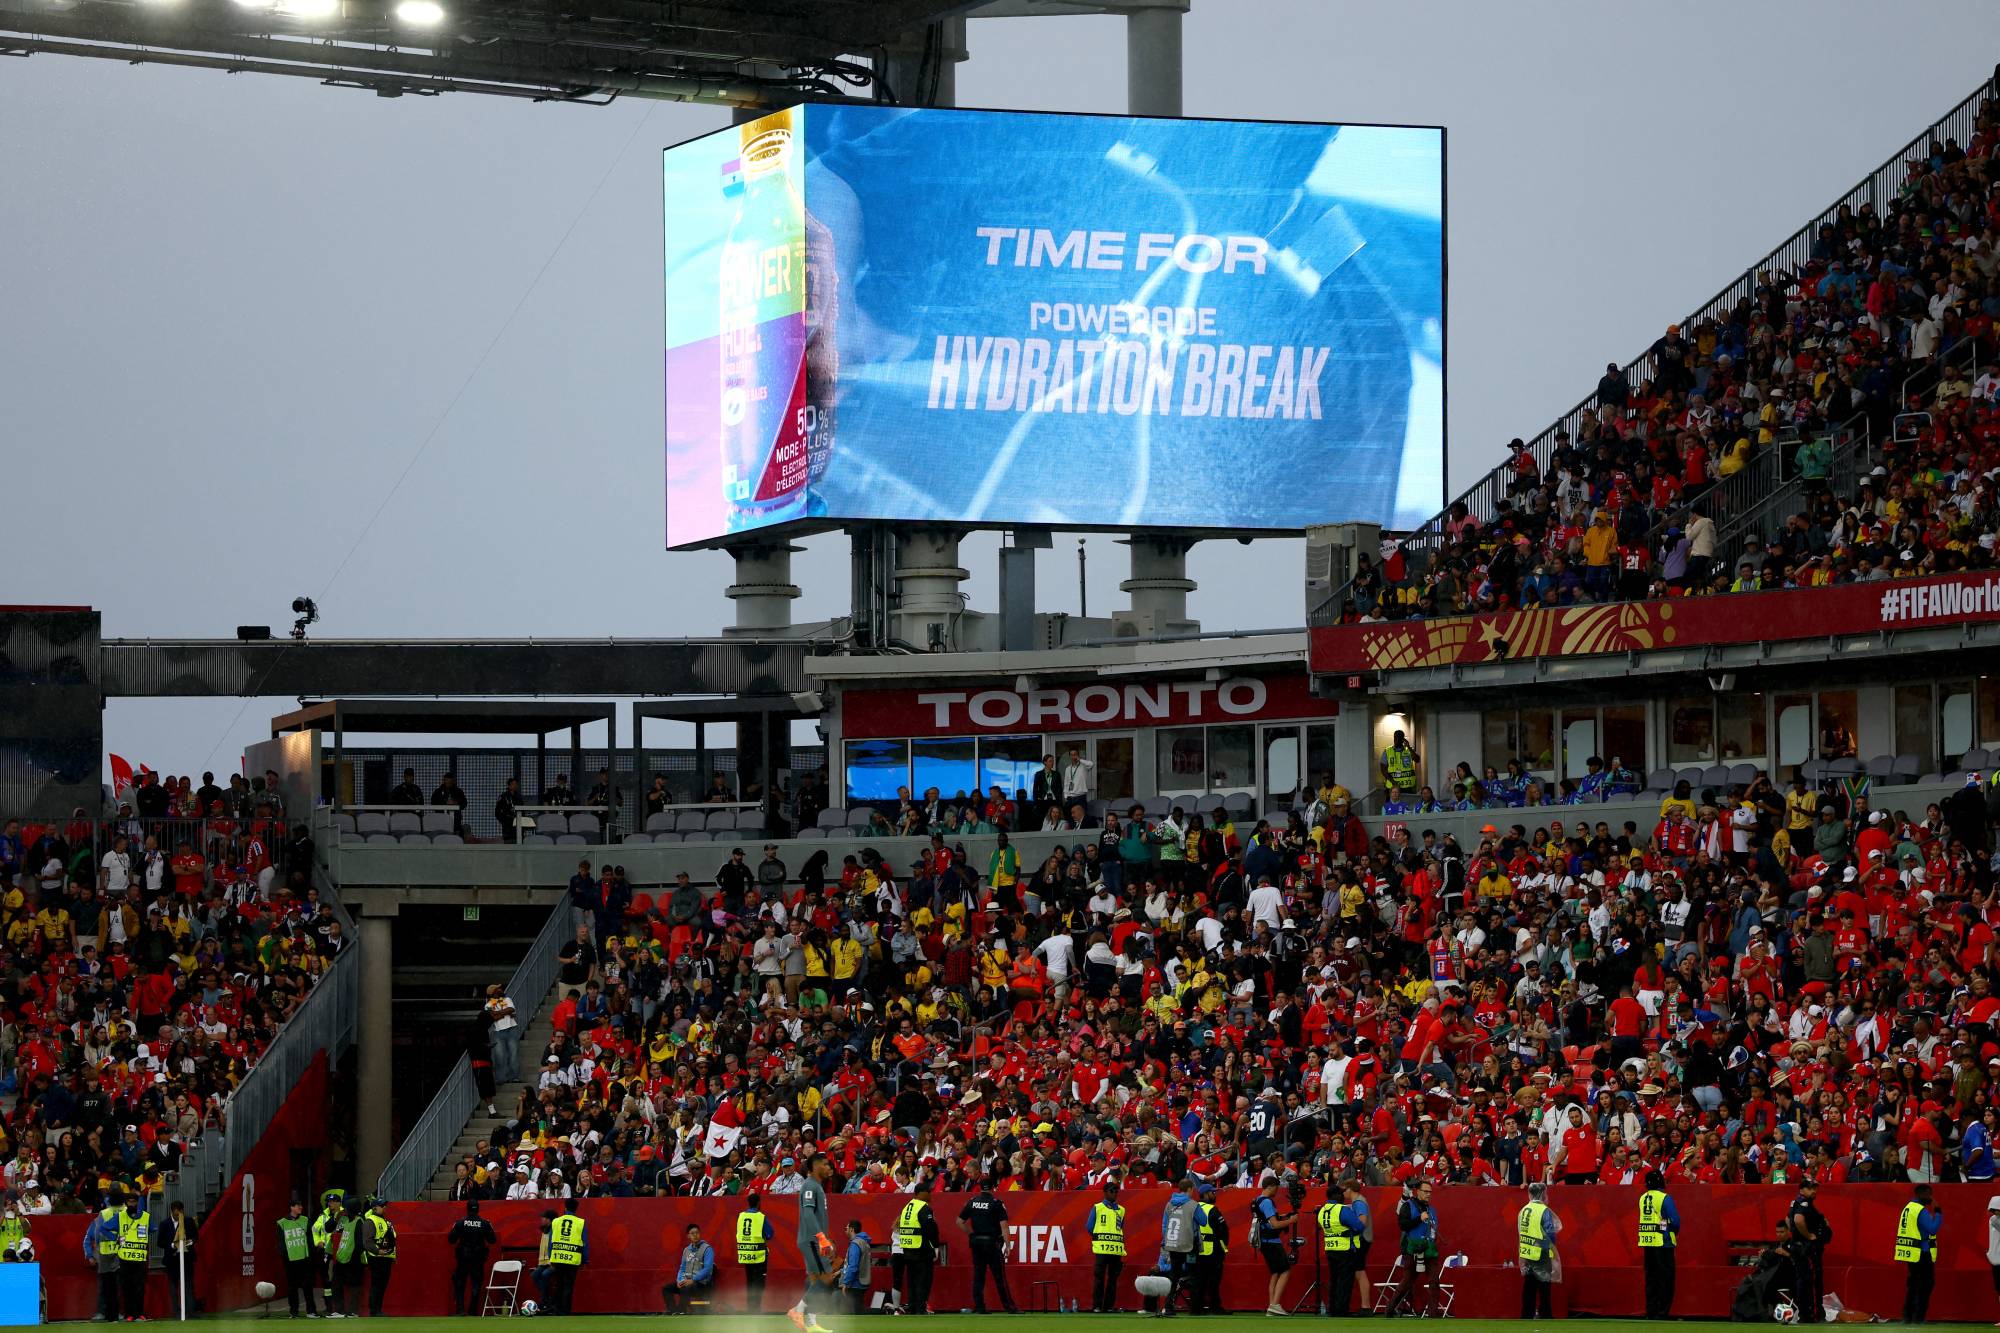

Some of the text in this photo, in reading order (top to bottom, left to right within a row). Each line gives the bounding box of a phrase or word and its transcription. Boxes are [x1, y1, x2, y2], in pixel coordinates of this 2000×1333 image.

[976, 227, 1268, 275] TIME FOR
[1030, 302, 1217, 336] POWERADE
[927, 335, 1331, 420] HYDRATION BREAK
[797, 405, 829, 436] 50%
[917, 678, 1268, 728] TORONTO
[1250, 1111, 1266, 1131] 20
[972, 1201, 990, 1210] POLICE
[464, 1219, 482, 1228] POLICE
[1101, 1244, 1122, 1252] 17511
